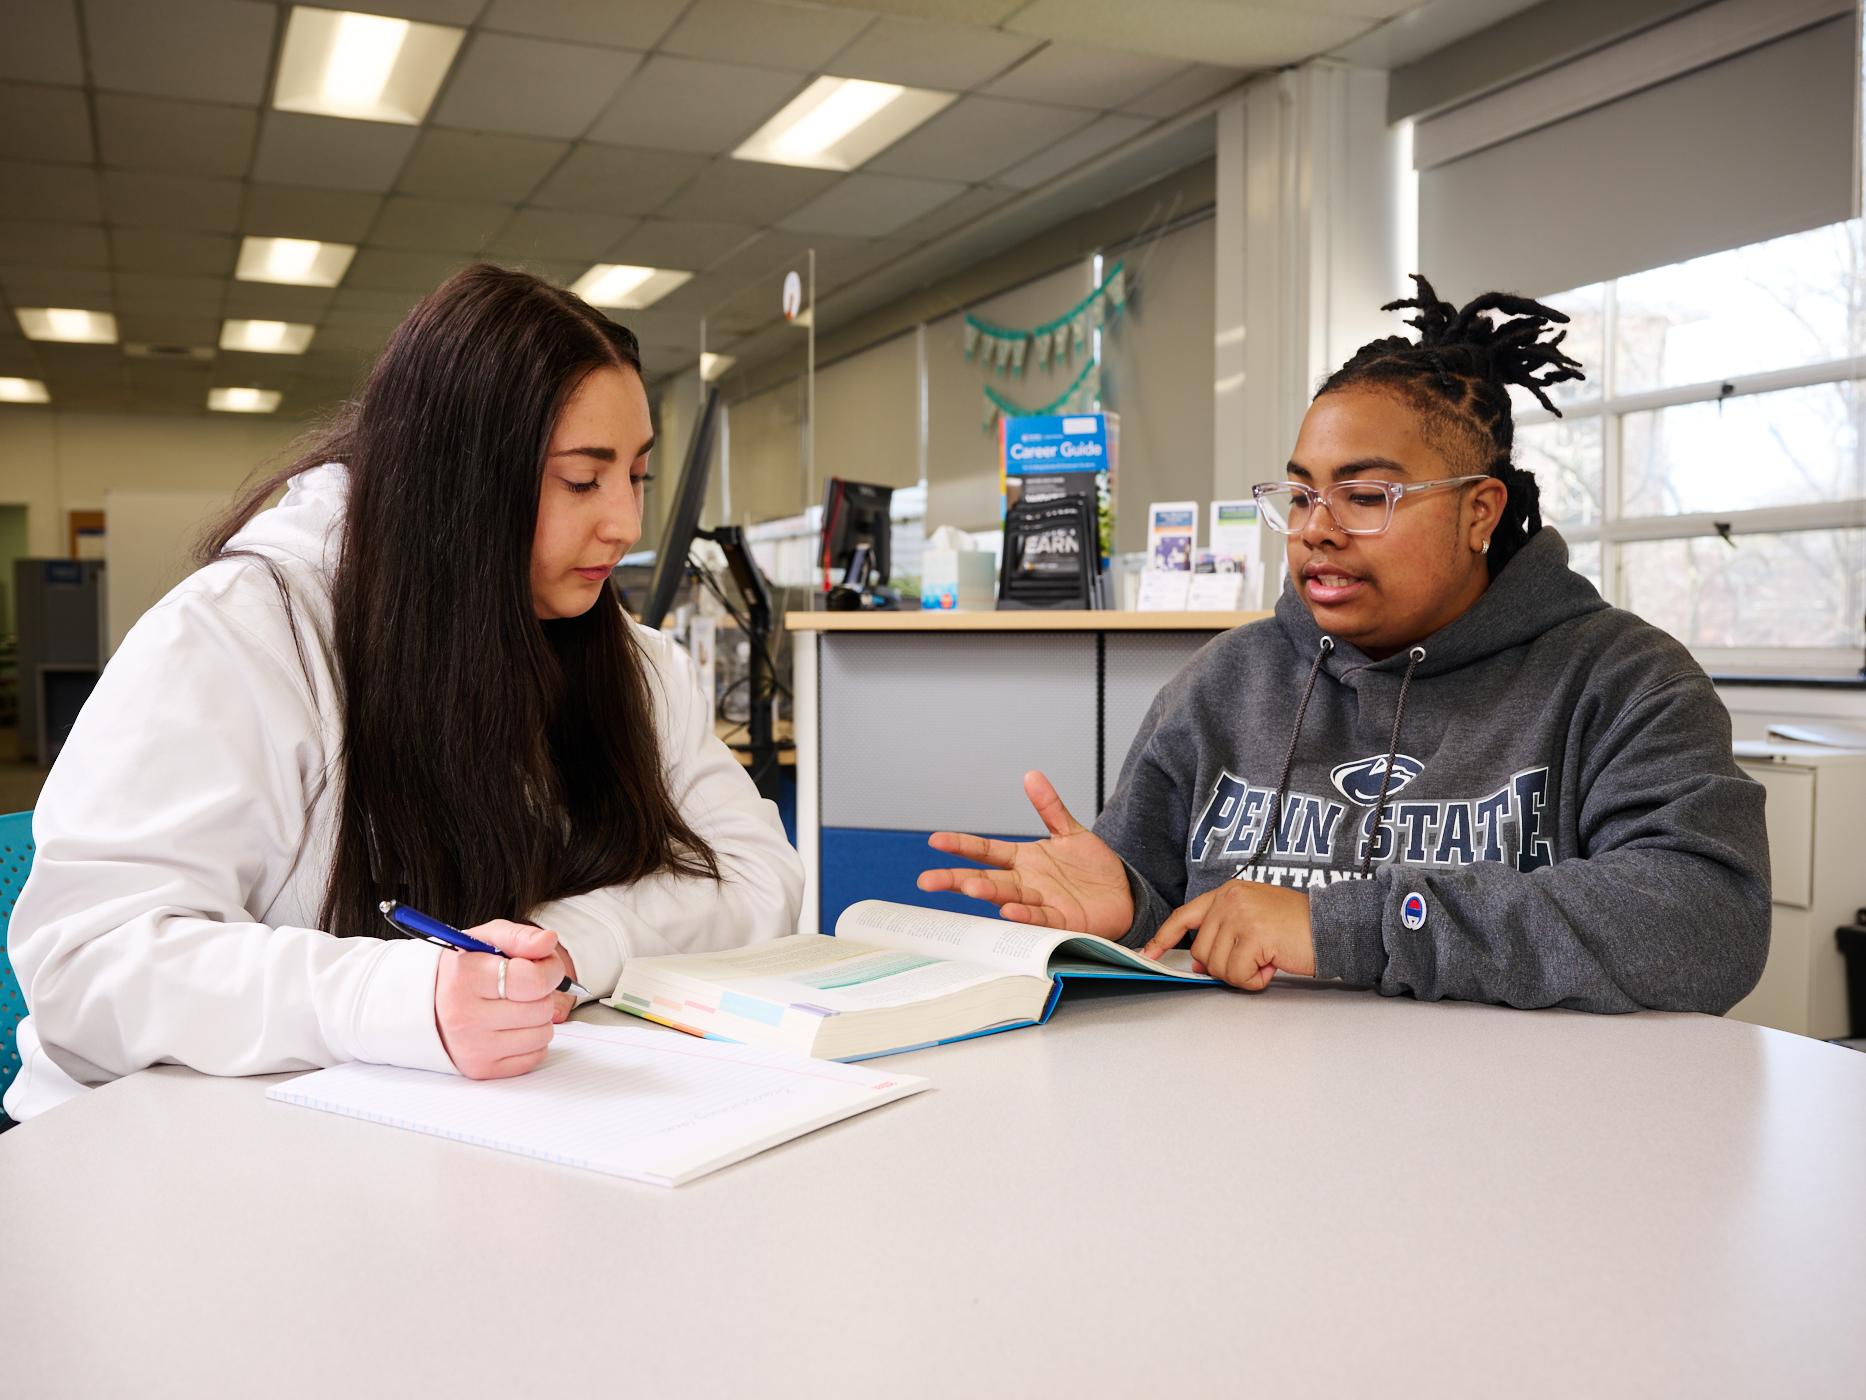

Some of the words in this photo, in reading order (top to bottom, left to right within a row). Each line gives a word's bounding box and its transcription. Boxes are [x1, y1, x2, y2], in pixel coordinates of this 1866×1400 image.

[1010, 443, 1058, 460] Career
[1060, 440, 1102, 458] Guide
[1191, 771, 1345, 862] PENN
[1358, 766, 1554, 873] STATE
